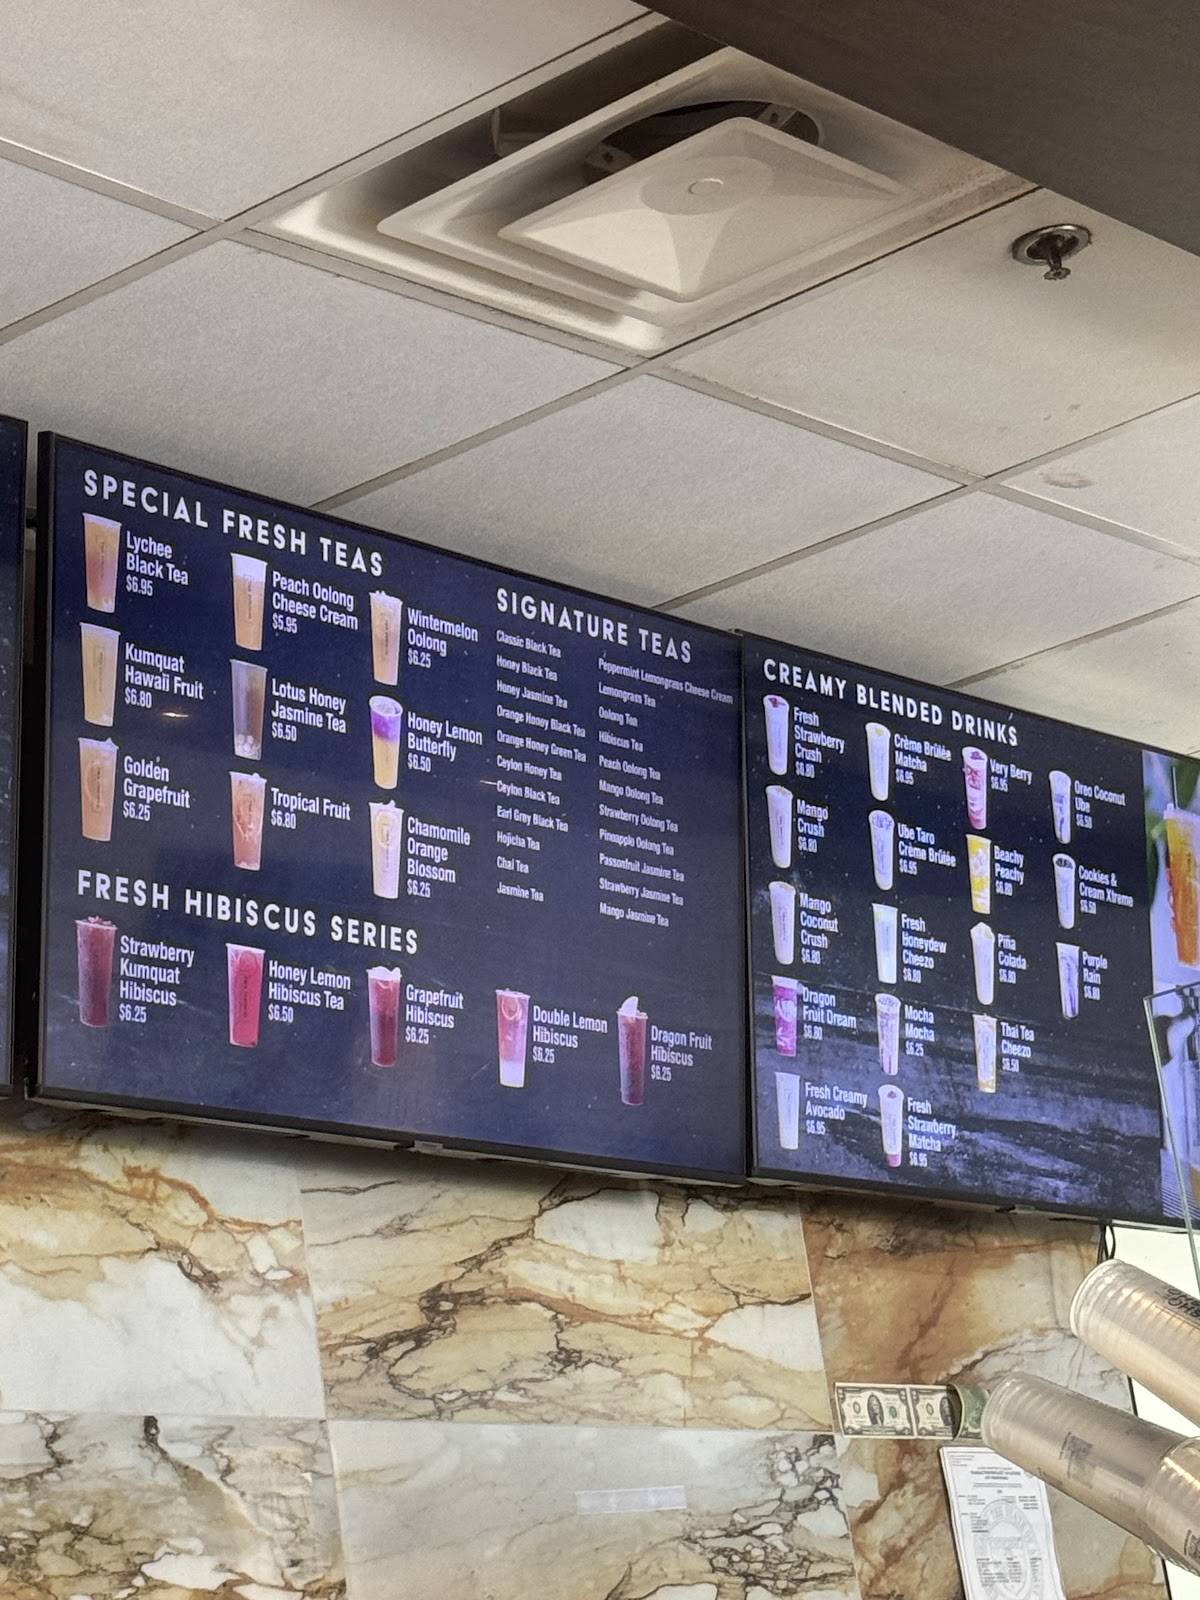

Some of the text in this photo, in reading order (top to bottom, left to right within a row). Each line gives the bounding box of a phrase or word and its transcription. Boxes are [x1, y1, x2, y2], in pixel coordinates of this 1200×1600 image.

[84, 469, 383, 577] SPECIAL FRESH TEAS
[126, 531, 172, 559] Lychee
[126, 554, 189, 585] Black Tea
[126, 575, 153, 597] $6.95
[272, 571, 354, 611] Peach Oolong
[272, 593, 358, 631] Cheese Cream
[272, 613, 297, 634] $5.95
[407, 607, 478, 642] Wintermelon
[497, 588, 691, 664] SIGNATURE TEAS
[408, 629, 447, 657] Oolong
[497, 629, 561, 658] Classic Black Tea
[125, 642, 185, 673] Kumquat
[407, 649, 431, 669] $6.25
[497, 654, 558, 682] Honey Black Tea
[125, 664, 204, 700] Hawaii Fruit
[598, 657, 640, 680] Peppermint
[684, 681, 709, 698] Cheese
[125, 687, 152, 708] $6.80
[272, 678, 346, 715] Lotus Honey
[497, 679, 568, 709] Honey Jasmine Tea
[643, 694, 656, 708] Tea
[763, 658, 1018, 747] CREAMY BLENDED DRINKS
[271, 700, 346, 733] Jasmine Tea
[408, 711, 483, 745] Honey Lemon
[497, 704, 524, 724] Orange
[550, 718, 571, 734] Black
[572, 723, 586, 738] Tea
[794, 706, 819, 727] Fresh
[271, 721, 297, 742] $6.50
[794, 724, 845, 754] Strawberry
[408, 732, 456, 762] Butterfly
[497, 729, 524, 749] Orange
[525, 737, 549, 756] Honey
[573, 748, 587, 763] Tea
[631, 738, 644, 753] Tea
[795, 742, 822, 764] Crush
[124, 755, 170, 782] Golden
[524, 762, 548, 780] Honey
[548, 766, 562, 781] Tea
[895, 750, 927, 772] Matcha
[123, 778, 190, 808] Grapefruit
[270, 787, 351, 821] Tropical Fruit
[524, 786, 546, 802] Black
[547, 791, 560, 806] Tea
[123, 800, 150, 822] $6.25
[270, 809, 296, 830] $6.80
[797, 798, 829, 822] Mango
[407, 816, 471, 845] Chamomile
[555, 818, 569, 833] Tea
[797, 817, 825, 838] Crush
[897, 822, 935, 845] Ube Taro
[407, 837, 448, 862] Orange
[526, 836, 540, 851] Tea
[407, 858, 456, 883] Blossom
[515, 859, 529, 874] Tea
[407, 879, 431, 898] $6.25
[497, 881, 544, 902] Jasmine Tea
[77, 869, 418, 955] FRESH HIBISCUS SERIES
[799, 892, 831, 915] Mango
[800, 911, 839, 933] Coconut
[901, 913, 926, 933] Fresh
[120, 935, 195, 968] Strawberry
[800, 929, 828, 949] Crush
[120, 957, 180, 985] Kumquat
[269, 960, 351, 990] Honey Lemon
[119, 980, 177, 1006] Hibiscus
[268, 981, 344, 1011] Hibiscus Tea
[405, 983, 464, 1010] Grapefruit
[802, 986, 836, 1008] Dragon
[119, 1003, 147, 1023] $6.25
[405, 1004, 455, 1029] Hibiscus
[532, 1005, 608, 1034] Double Lemon
[803, 1004, 857, 1029] Fruit Dream
[904, 1003, 935, 1024] Mocha
[405, 1025, 429, 1045] $6.25
[532, 1025, 578, 1049] Hibiscus
[651, 1025, 713, 1051] Dragon Fruit
[905, 1022, 935, 1042] Mocha
[1020, 1024, 1035, 1042] Tea
[651, 1045, 694, 1067] Hibiscus
[805, 1081, 868, 1109] Fresh Creamy
[907, 1096, 932, 1115] Fresh
[805, 1100, 845, 1121] Avocado
[908, 1115, 956, 1139] Strawberry
[908, 1132, 941, 1153] Matcha
